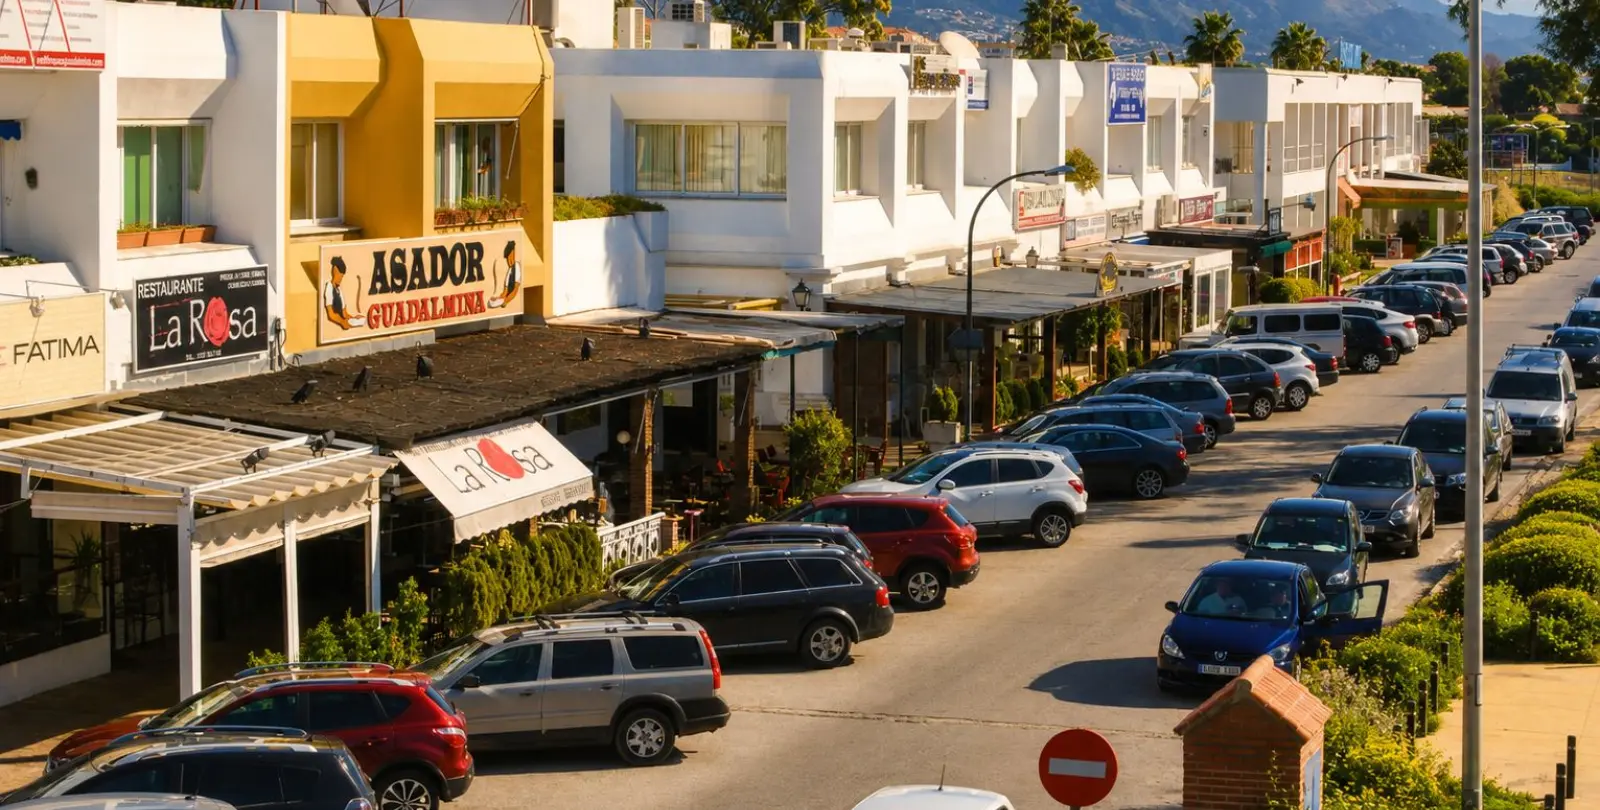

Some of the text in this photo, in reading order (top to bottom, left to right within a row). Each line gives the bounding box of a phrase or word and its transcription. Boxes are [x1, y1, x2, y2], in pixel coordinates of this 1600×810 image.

[368, 241, 485, 295] ASADOR
[138, 277, 204, 299] RESTAURANTE
[149, 305, 182, 352] La
[367, 290, 486, 329] GUADALMINA
[13, 335, 100, 365] FATIMA
[428, 457, 486, 494] La
